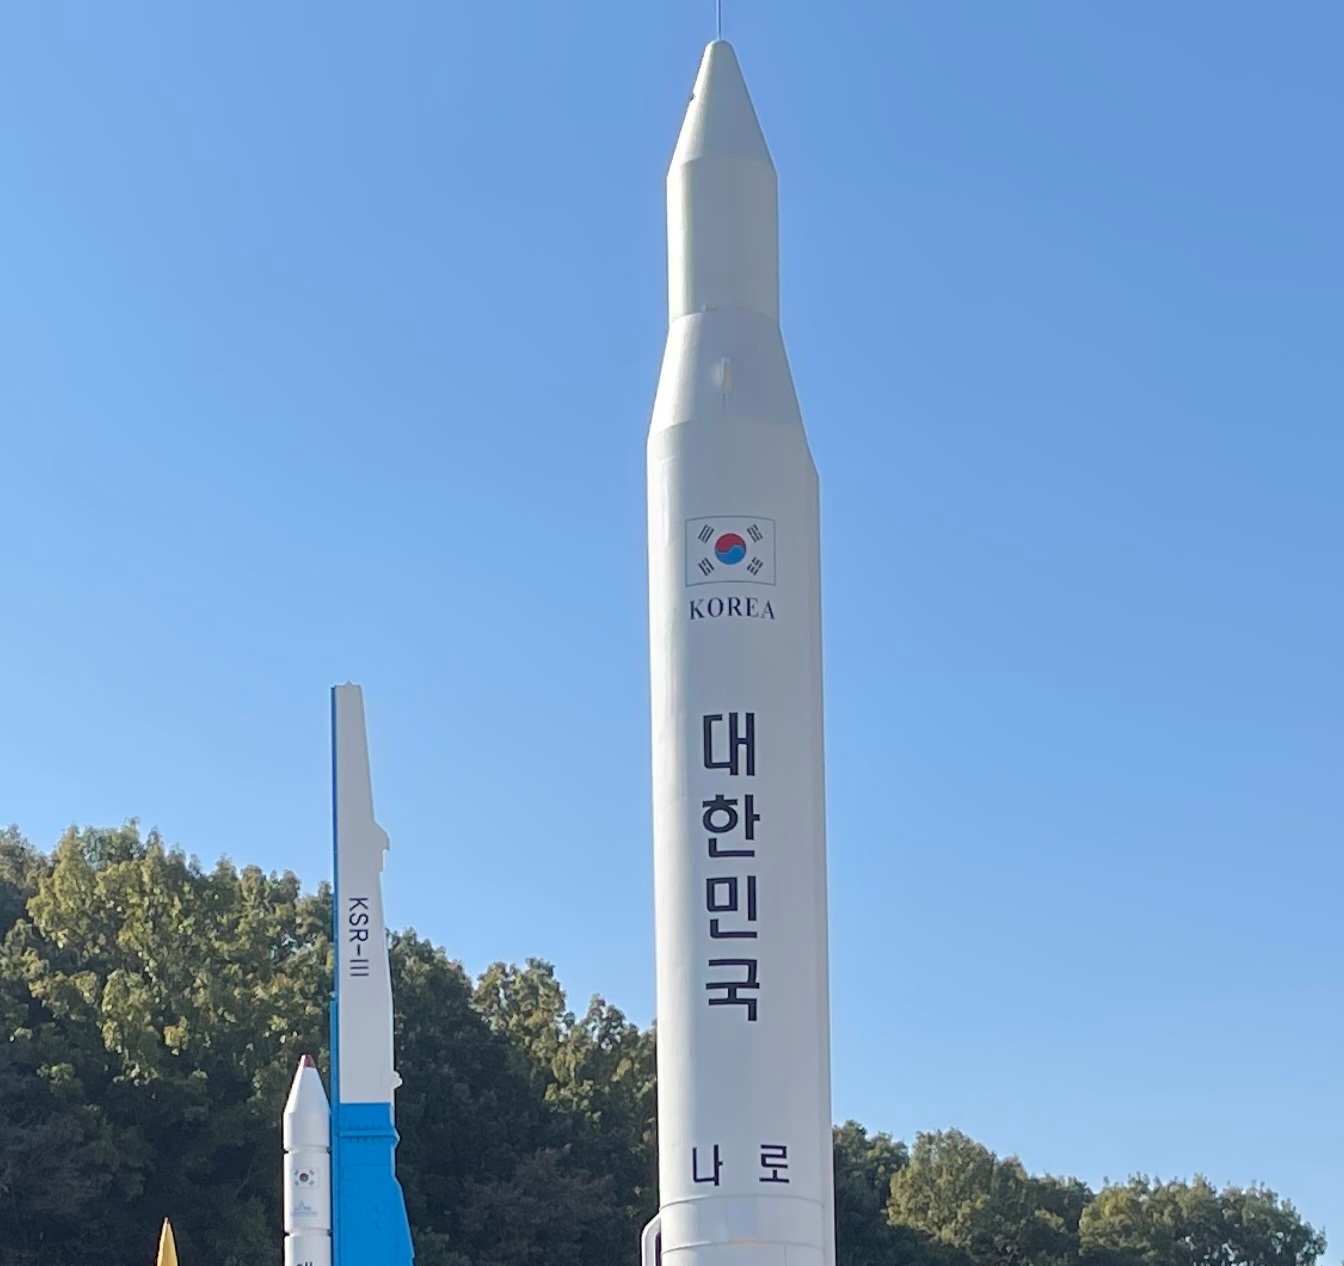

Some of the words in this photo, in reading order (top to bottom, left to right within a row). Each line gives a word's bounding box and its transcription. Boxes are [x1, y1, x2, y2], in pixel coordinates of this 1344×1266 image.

[689, 596, 776, 621] KOREA
[702, 711, 761, 1022] 대한민국
[348, 897, 369, 977] KSR-III
